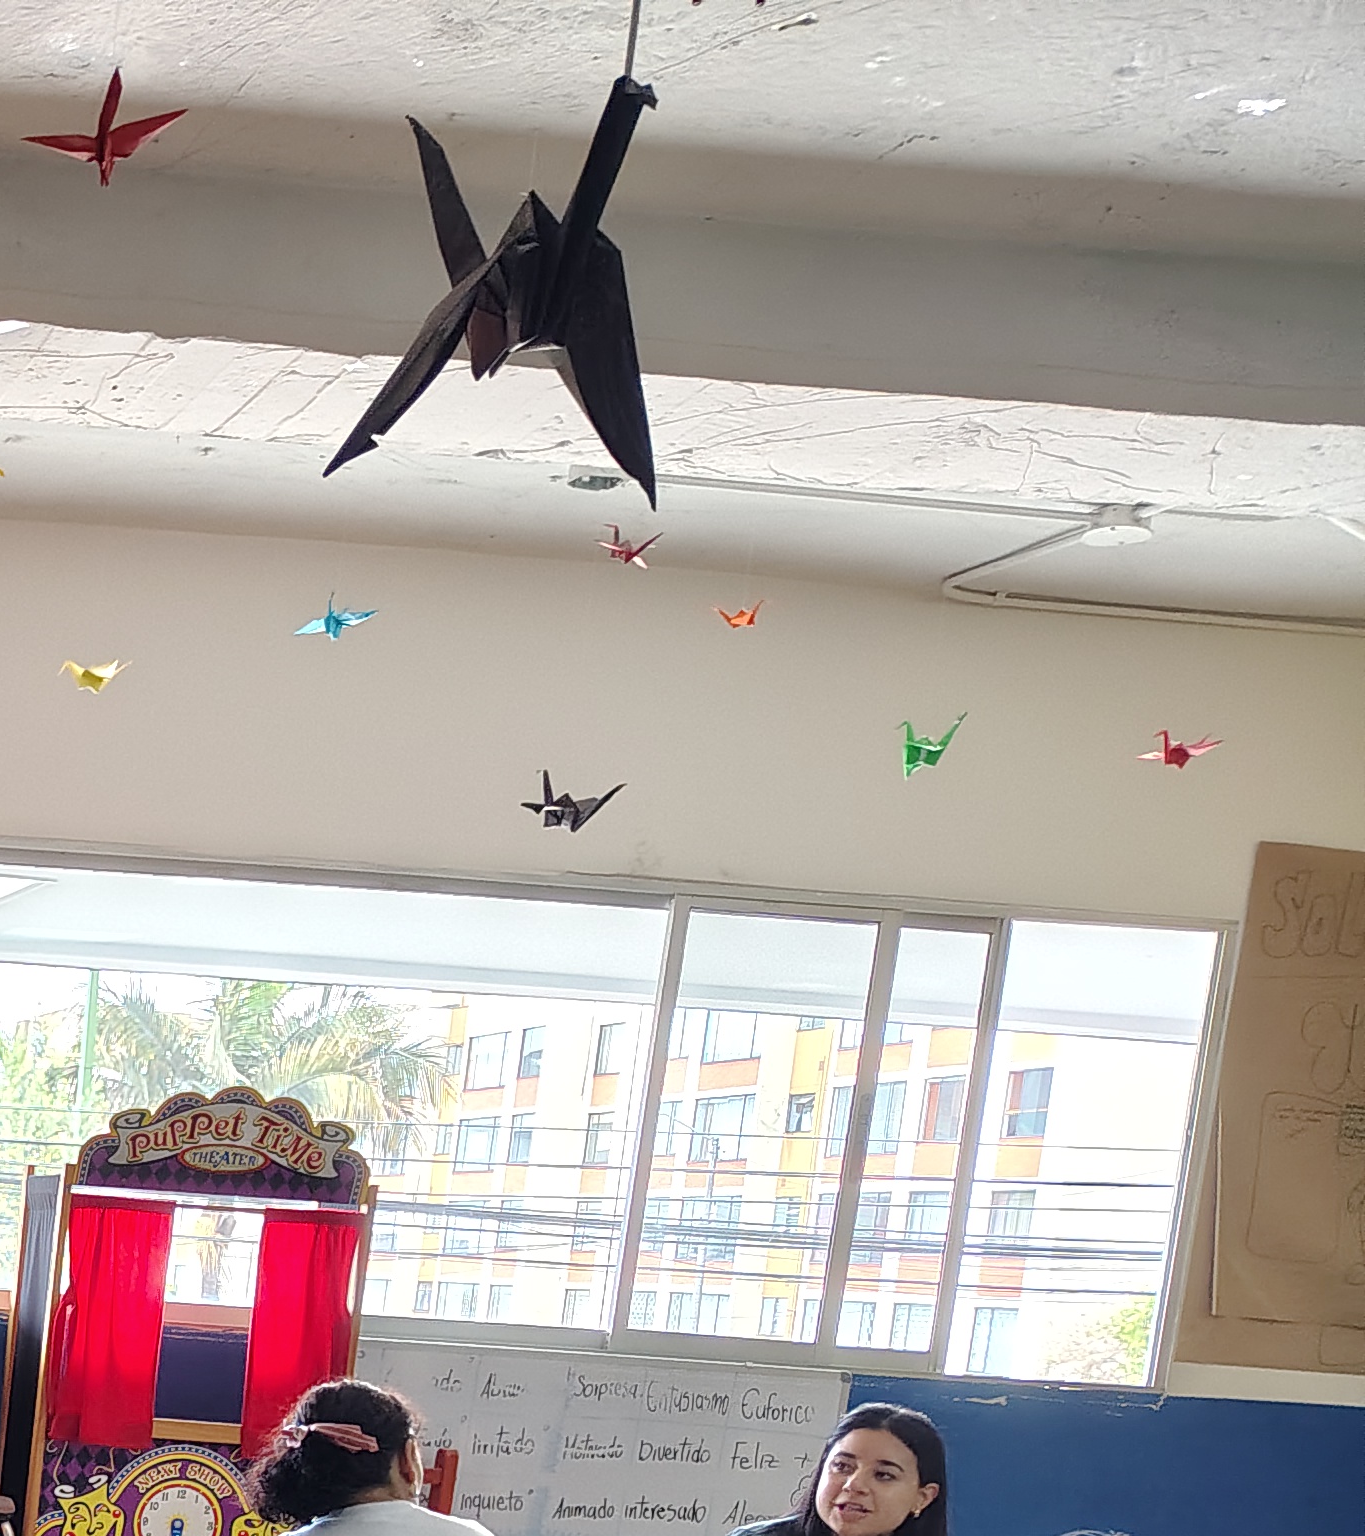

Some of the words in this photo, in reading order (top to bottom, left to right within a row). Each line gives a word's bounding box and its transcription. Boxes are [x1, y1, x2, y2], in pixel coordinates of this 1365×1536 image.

[190, 1150, 257, 1168] THEATER
[638, 1437, 711, 1463] Divertido
[731, 1442, 780, 1469] Feliz
[136, 1463, 182, 1490] NEXT
[187, 1464, 231, 1497] SHOW
[161, 1492, 169, 1501] 11
[176, 1490, 187, 1499] 12
[149, 1502, 159, 1511] 10
[204, 1506, 211, 1515] 2
[551, 1497, 614, 1519] Animado
